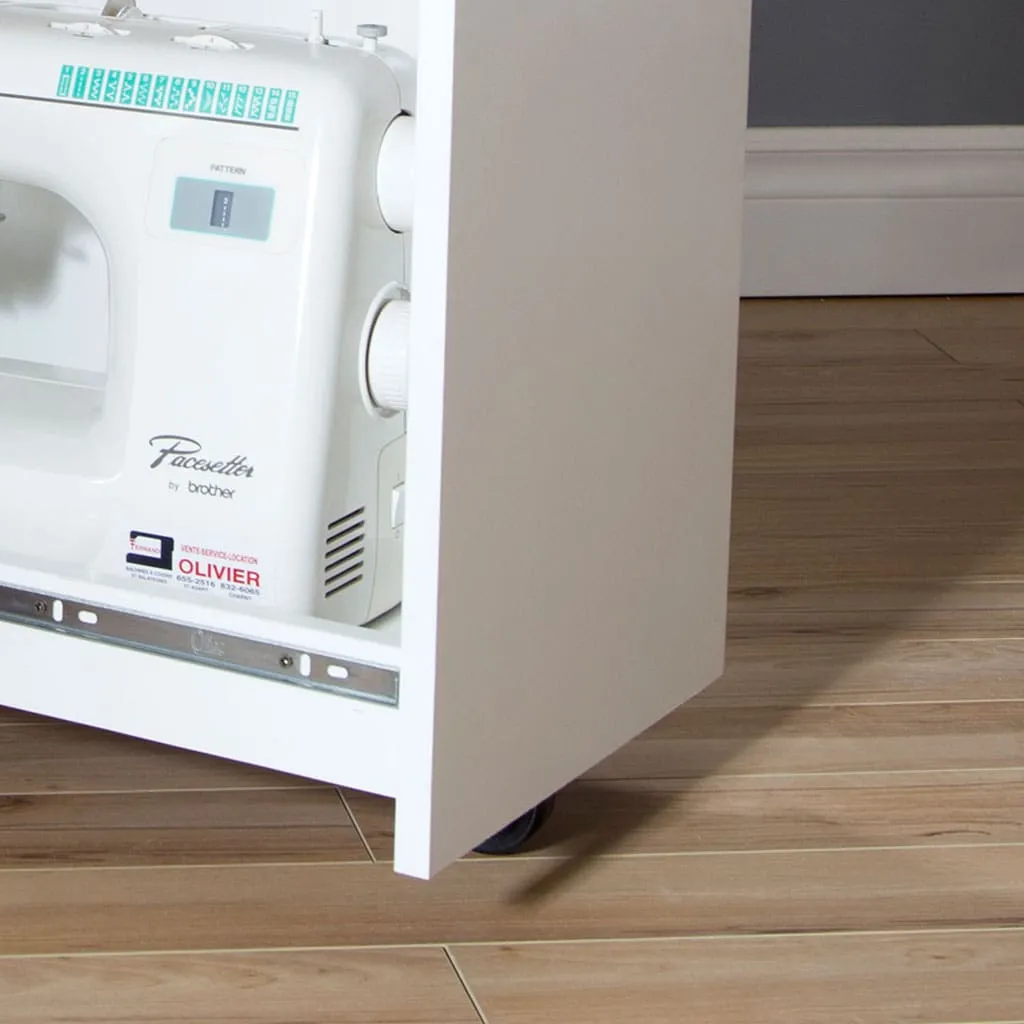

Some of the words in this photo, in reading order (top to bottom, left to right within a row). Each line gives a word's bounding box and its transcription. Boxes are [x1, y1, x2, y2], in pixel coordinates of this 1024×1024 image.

[210, 164, 247, 175] PATTERN
[149, 435, 254, 478] Pacesetter
[168, 481, 179, 491] by
[188, 481, 235, 498] brother
[178, 558, 261, 587] OLIVIER
